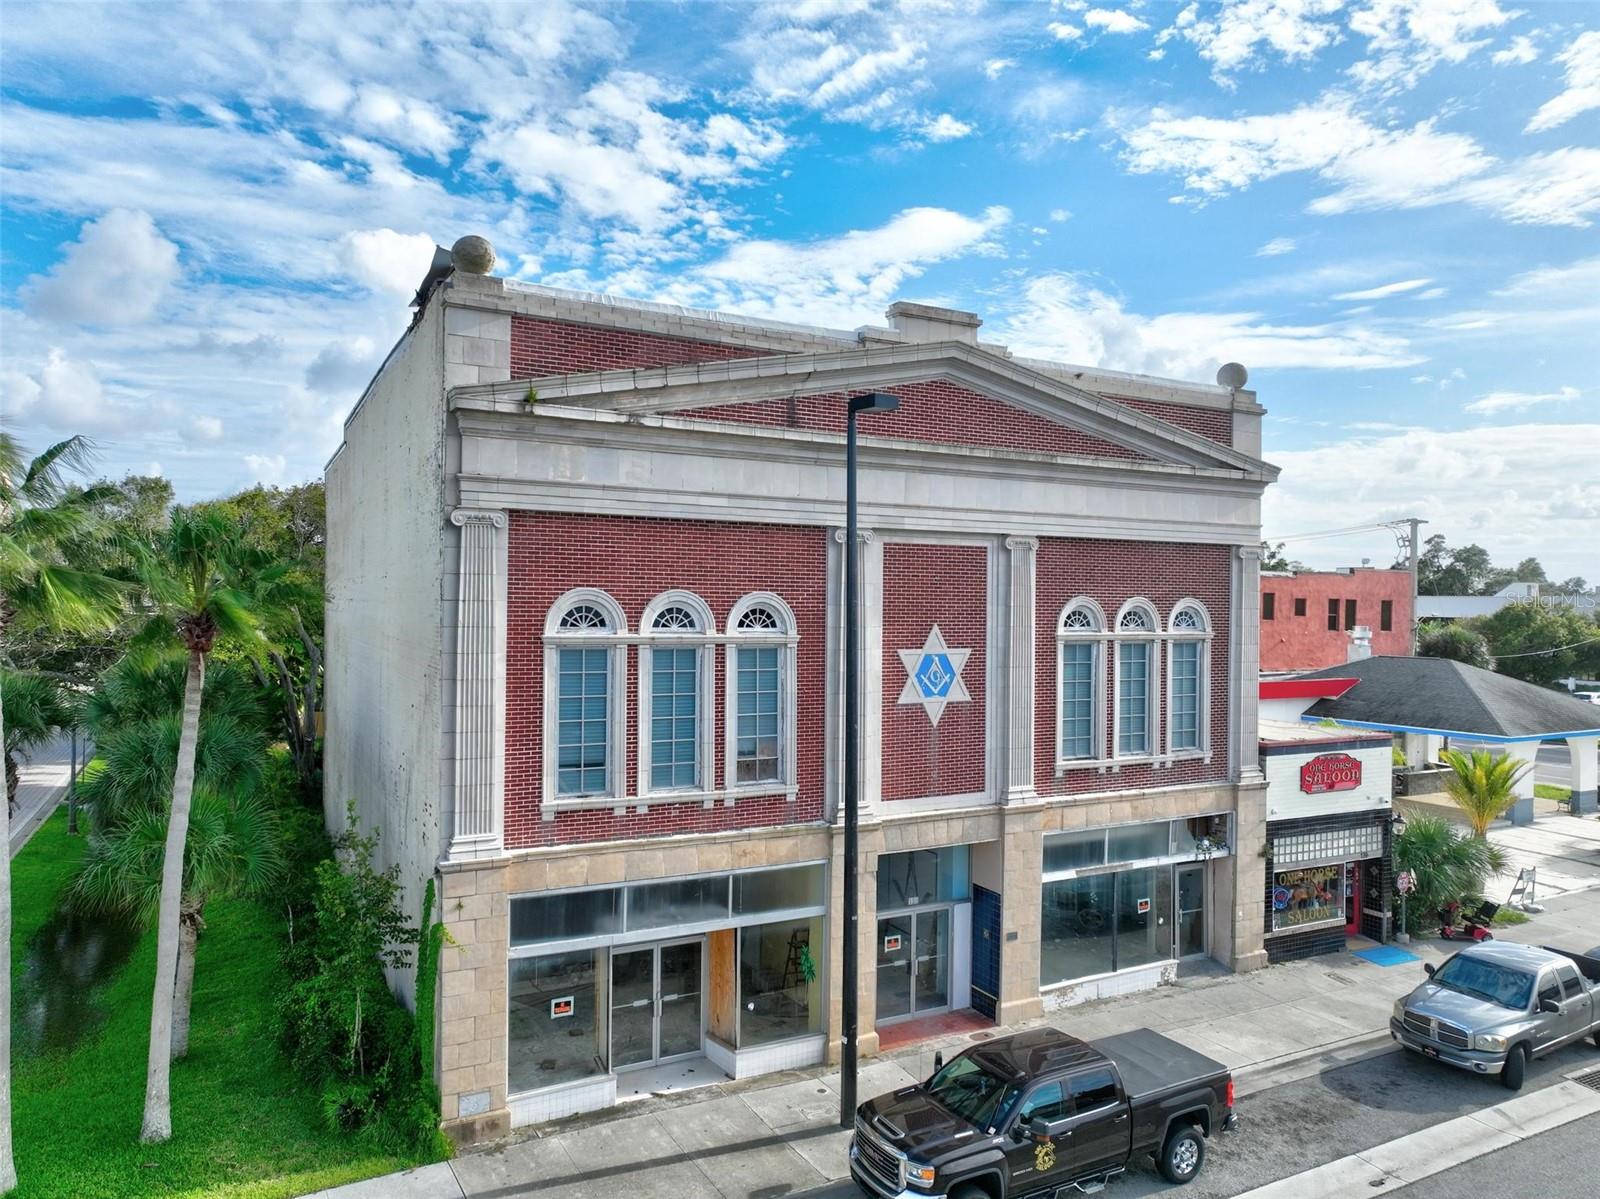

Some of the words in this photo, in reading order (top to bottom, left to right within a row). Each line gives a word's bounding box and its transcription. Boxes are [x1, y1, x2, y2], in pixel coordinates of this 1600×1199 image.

[930, 670, 940, 685] G
[1310, 764, 1326, 772] ONE
[1329, 761, 1355, 770] HORSE
[1305, 769, 1360, 785] SALOON
[1279, 870, 1304, 886] ONE
[1304, 866, 1338, 883] HORSE
[1287, 905, 1330, 924] SALOON
